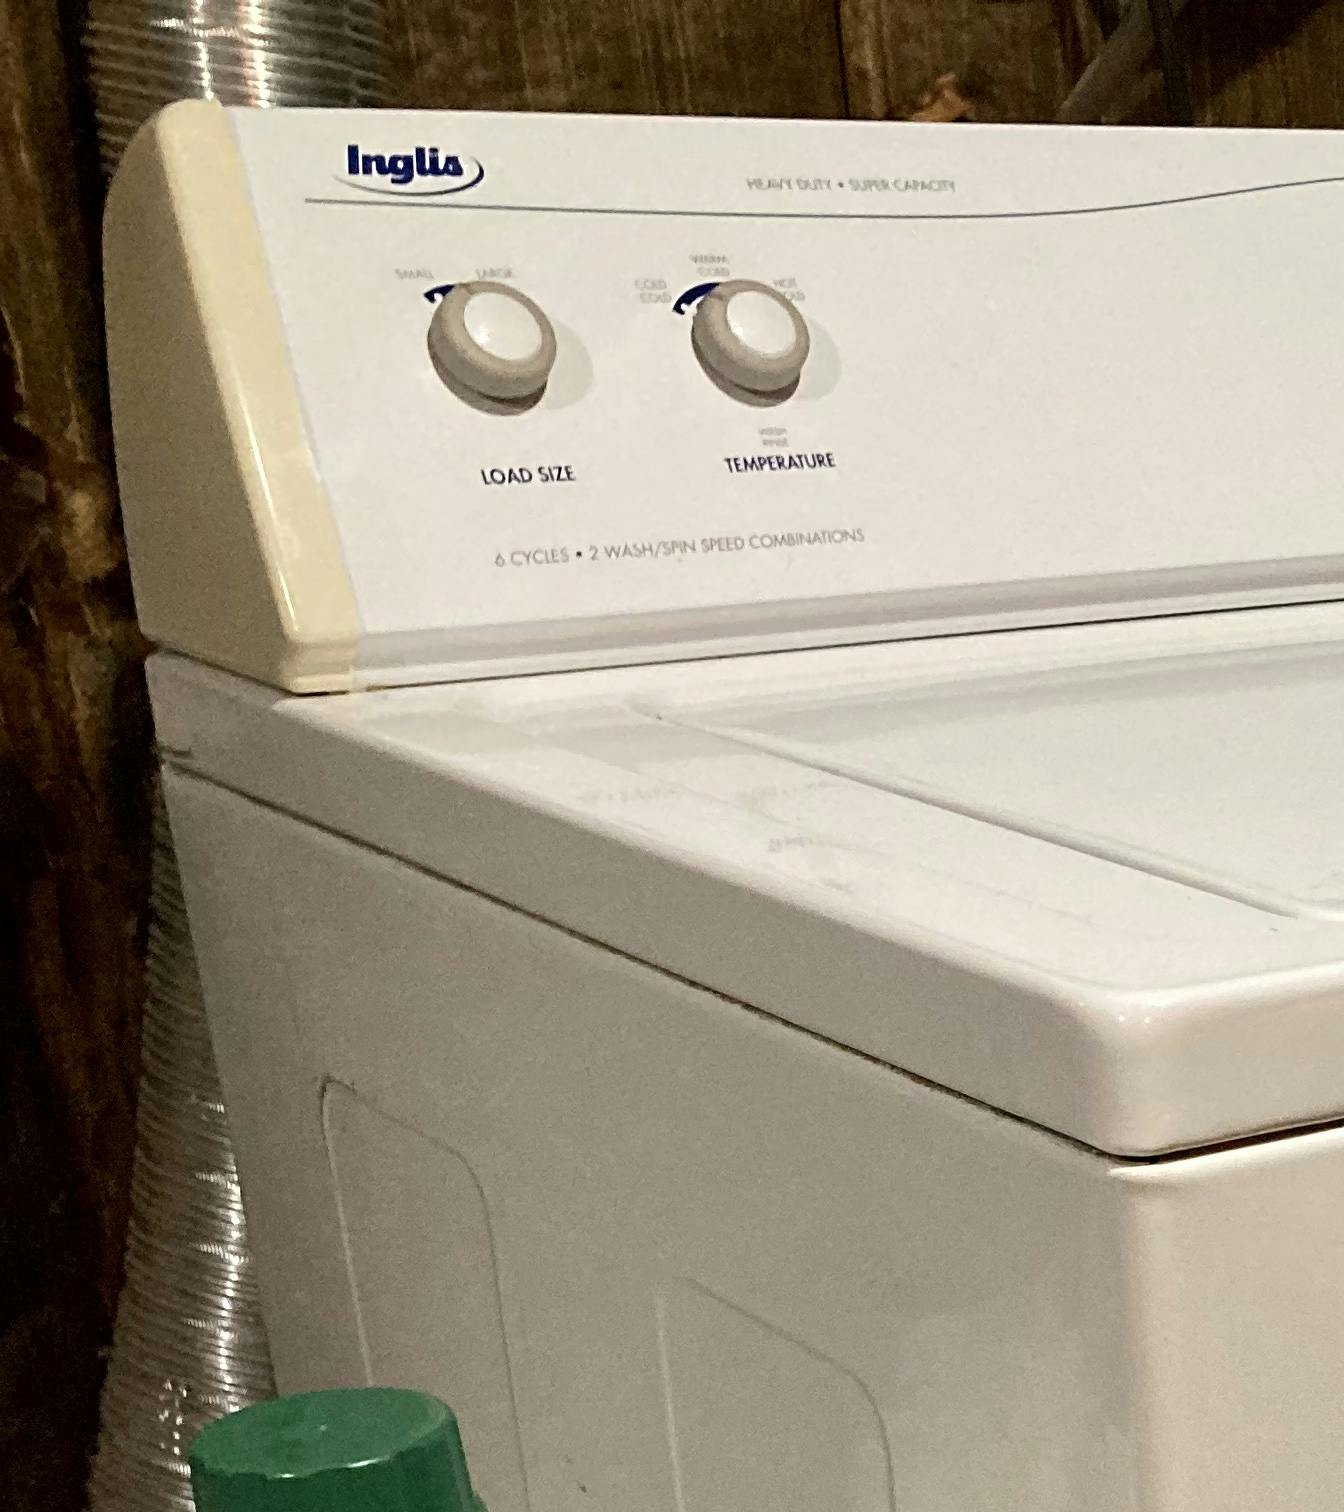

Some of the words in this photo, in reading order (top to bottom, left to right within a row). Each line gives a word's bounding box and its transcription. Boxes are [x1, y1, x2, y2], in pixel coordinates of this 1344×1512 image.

[347, 144, 464, 184] Inglis
[747, 178, 792, 190] HEAVY
[796, 178, 832, 191] DUTY
[849, 179, 889, 192] SUPER
[893, 179, 955, 192] CAPACITY
[724, 453, 836, 473] TEMPERATURE
[481, 467, 533, 485] LOAD
[538, 465, 577, 482] SIZE
[495, 552, 506, 567] 6
[510, 548, 570, 567] CYCLES
[589, 545, 599, 561] 2
[603, 539, 697, 560] WASH/SPIN
[701, 536, 745, 554] SPEED
[749, 528, 866, 550] COMBINATIONS
